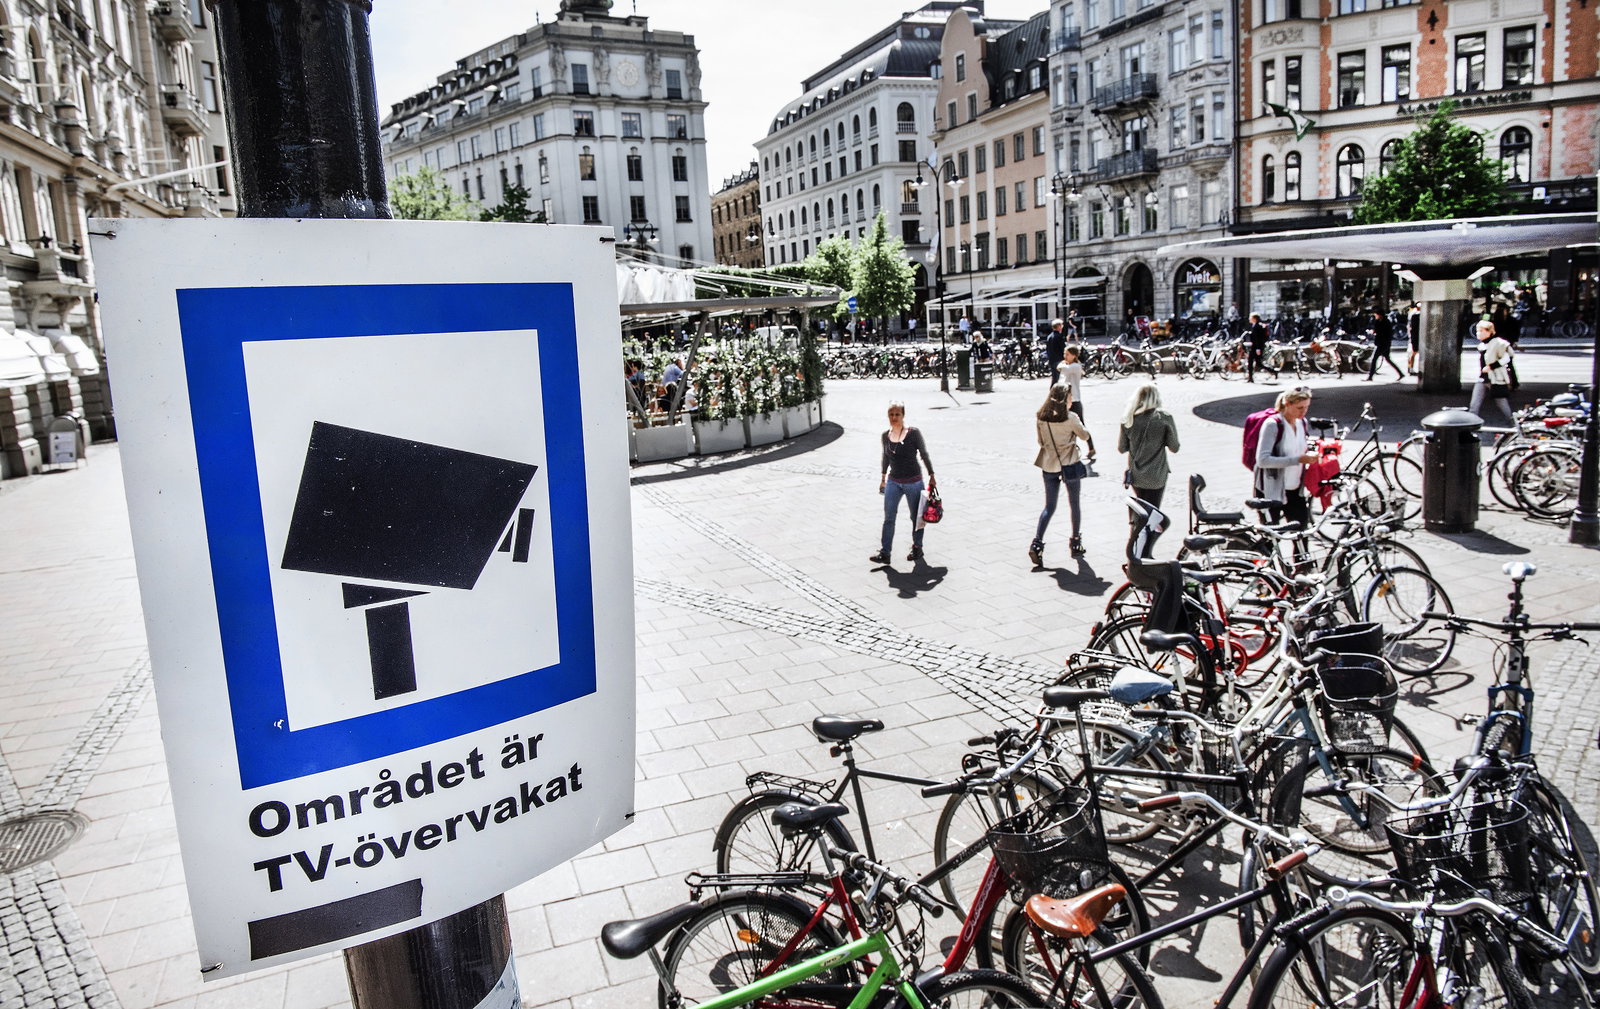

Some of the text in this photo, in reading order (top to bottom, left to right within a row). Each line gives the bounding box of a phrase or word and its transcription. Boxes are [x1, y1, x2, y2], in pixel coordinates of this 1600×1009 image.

[248, 733, 544, 838] Området är
[253, 762, 583, 893] TV-övervakat
